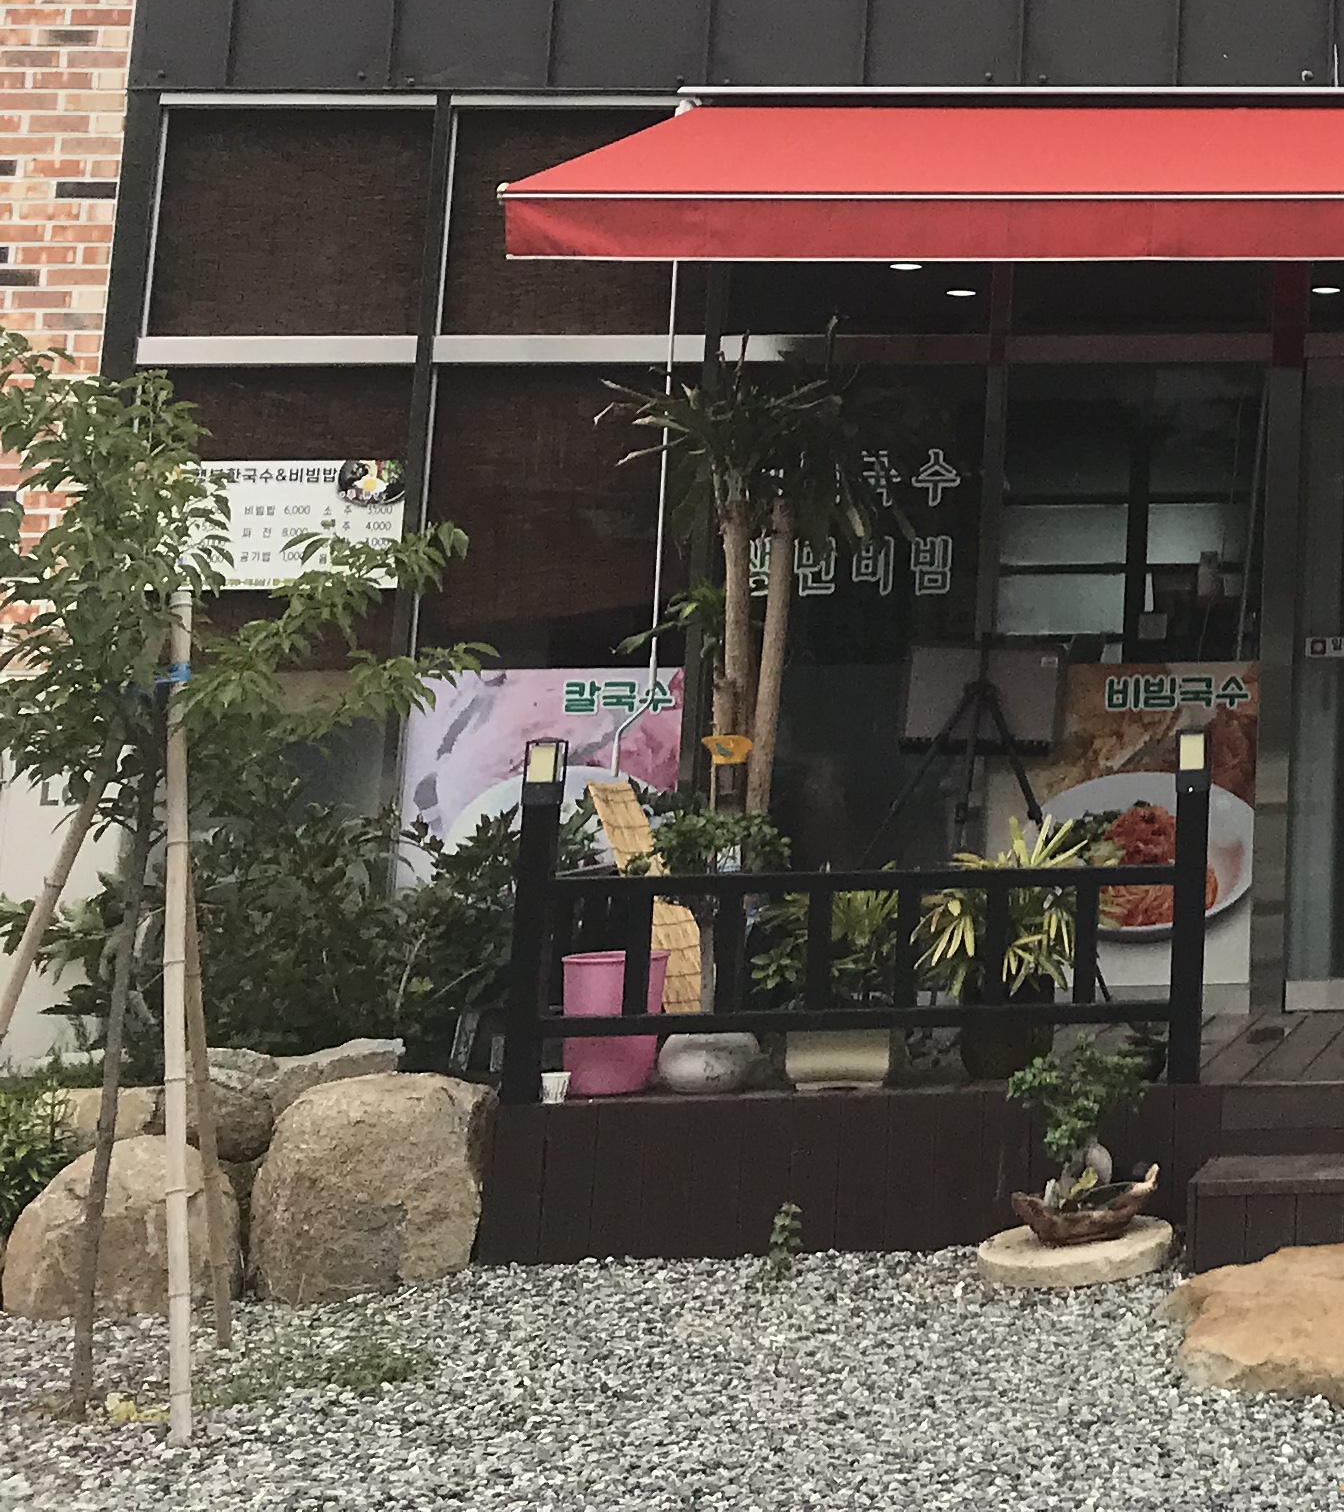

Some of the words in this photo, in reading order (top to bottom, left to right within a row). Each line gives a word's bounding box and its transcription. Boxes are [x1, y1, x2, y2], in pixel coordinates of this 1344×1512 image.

[283, 504, 311, 516] 6,000
[365, 520, 392, 532] 4,000
[563, 679, 676, 716] 칼국수
[1104, 673, 1250, 712] 비빔국수
